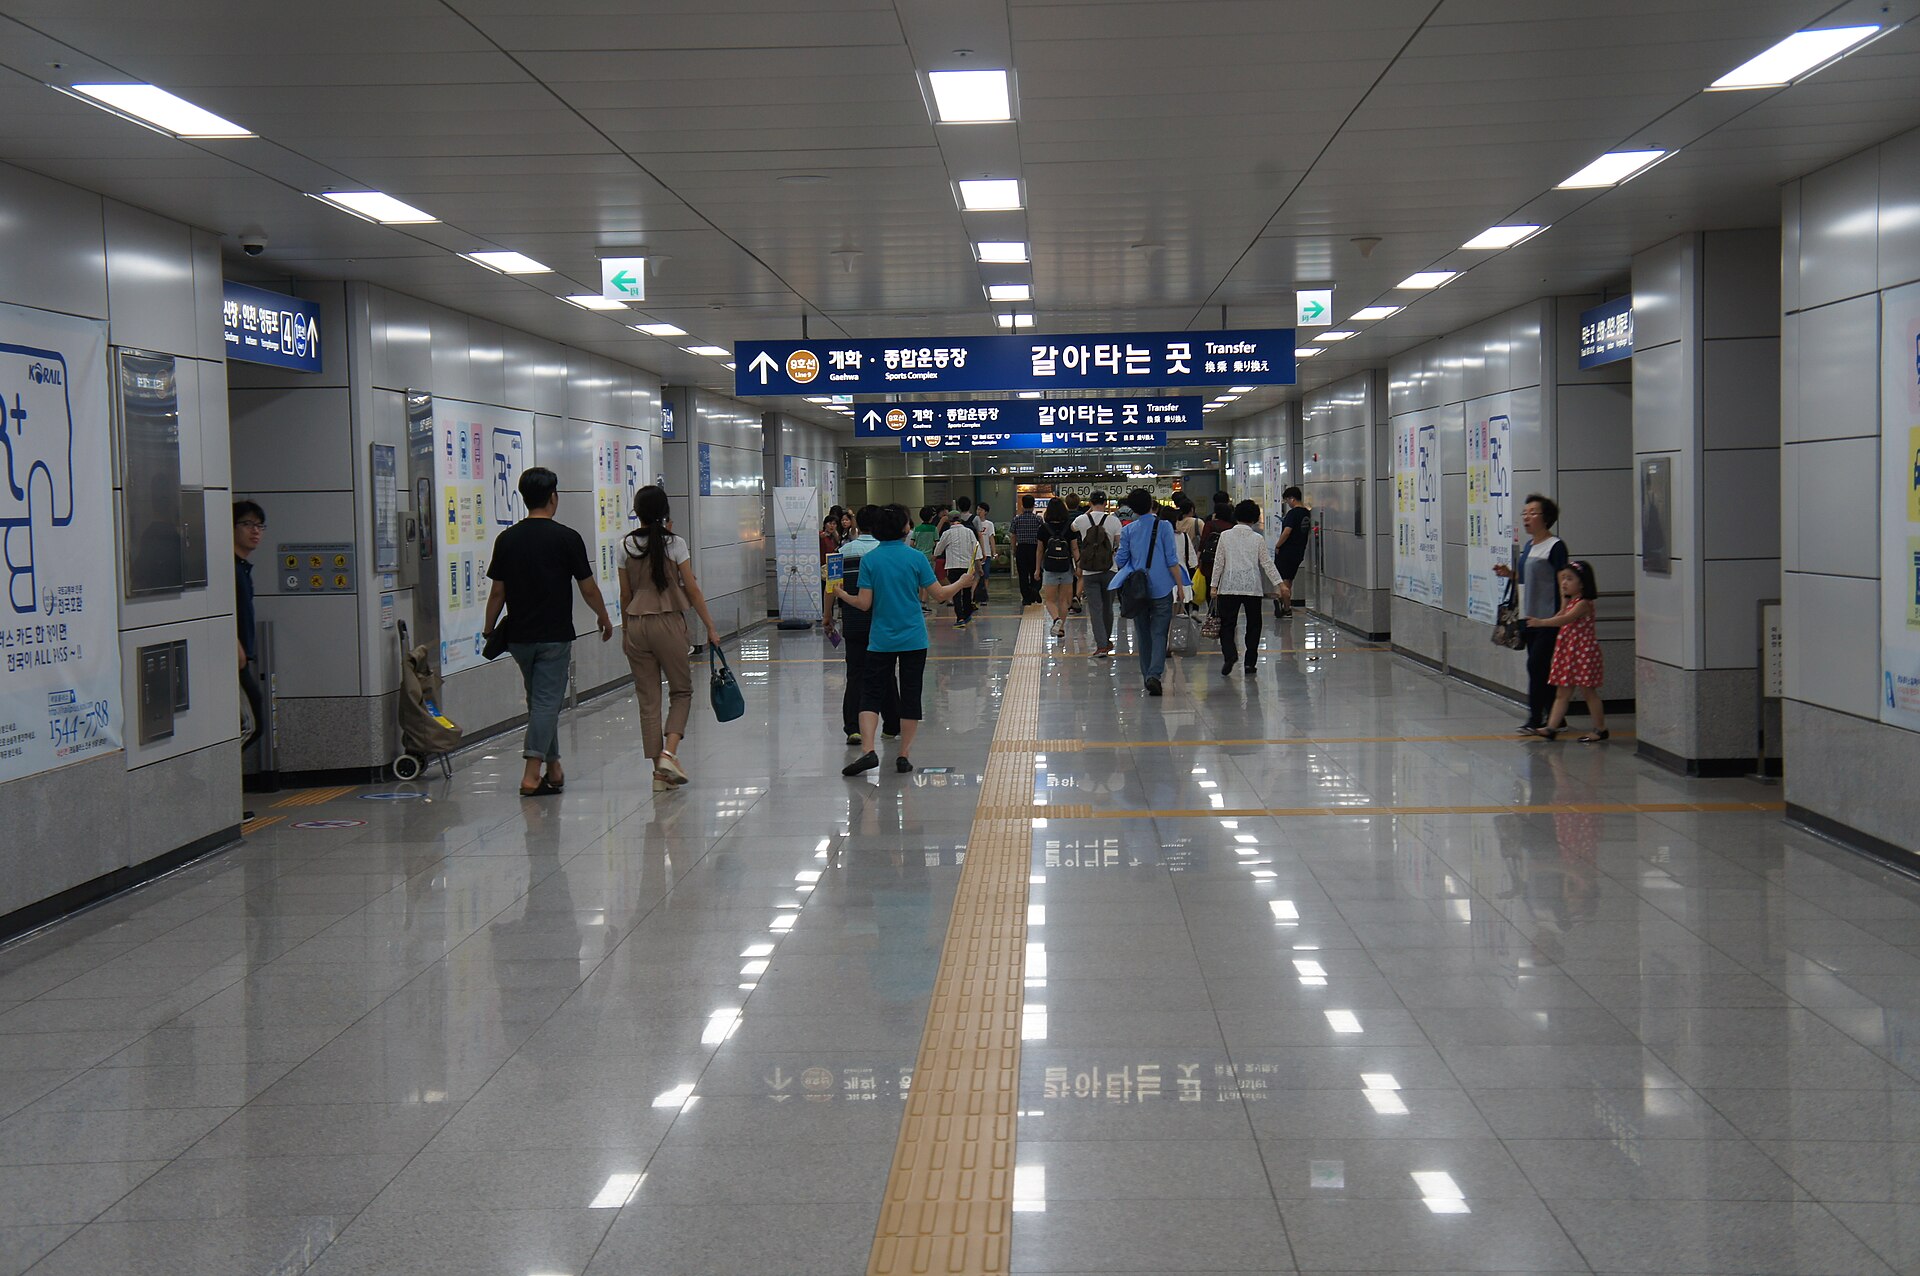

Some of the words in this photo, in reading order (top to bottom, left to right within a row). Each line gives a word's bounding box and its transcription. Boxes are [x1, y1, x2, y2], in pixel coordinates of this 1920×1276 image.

[284, 318, 292, 349] 4
[1205, 341, 1257, 354] Transfer
[790, 358, 816, 370] 9호선
[828, 350, 862, 369] 개화
[884, 348, 968, 368] 종합운동장
[1031, 344, 1151, 376] 갈아타는
[1165, 342, 1192, 374] 곳
[830, 373, 859, 381] Gaehwa
[885, 372, 907, 381] Sports
[908, 371, 938, 380] Complex
[912, 409, 934, 422] 개화
[946, 408, 999, 421] 종합운동장
[1038, 405, 1114, 426] 갈아타는
[1122, 404, 1138, 424] 곳
[1147, 403, 1179, 412] Transfer
[1061, 486, 1074, 496] 50
[1077, 486, 1090, 496] 50
[1110, 486, 1122, 495] 50
[17, 627, 32, 645] 카드
[36, 625, 44, 643] 한
[8, 651, 32, 672] 전국이
[35, 649, 52, 665] ALL
[53, 646, 68, 663] PASS
[49, 700, 108, 748] 1544-7788
